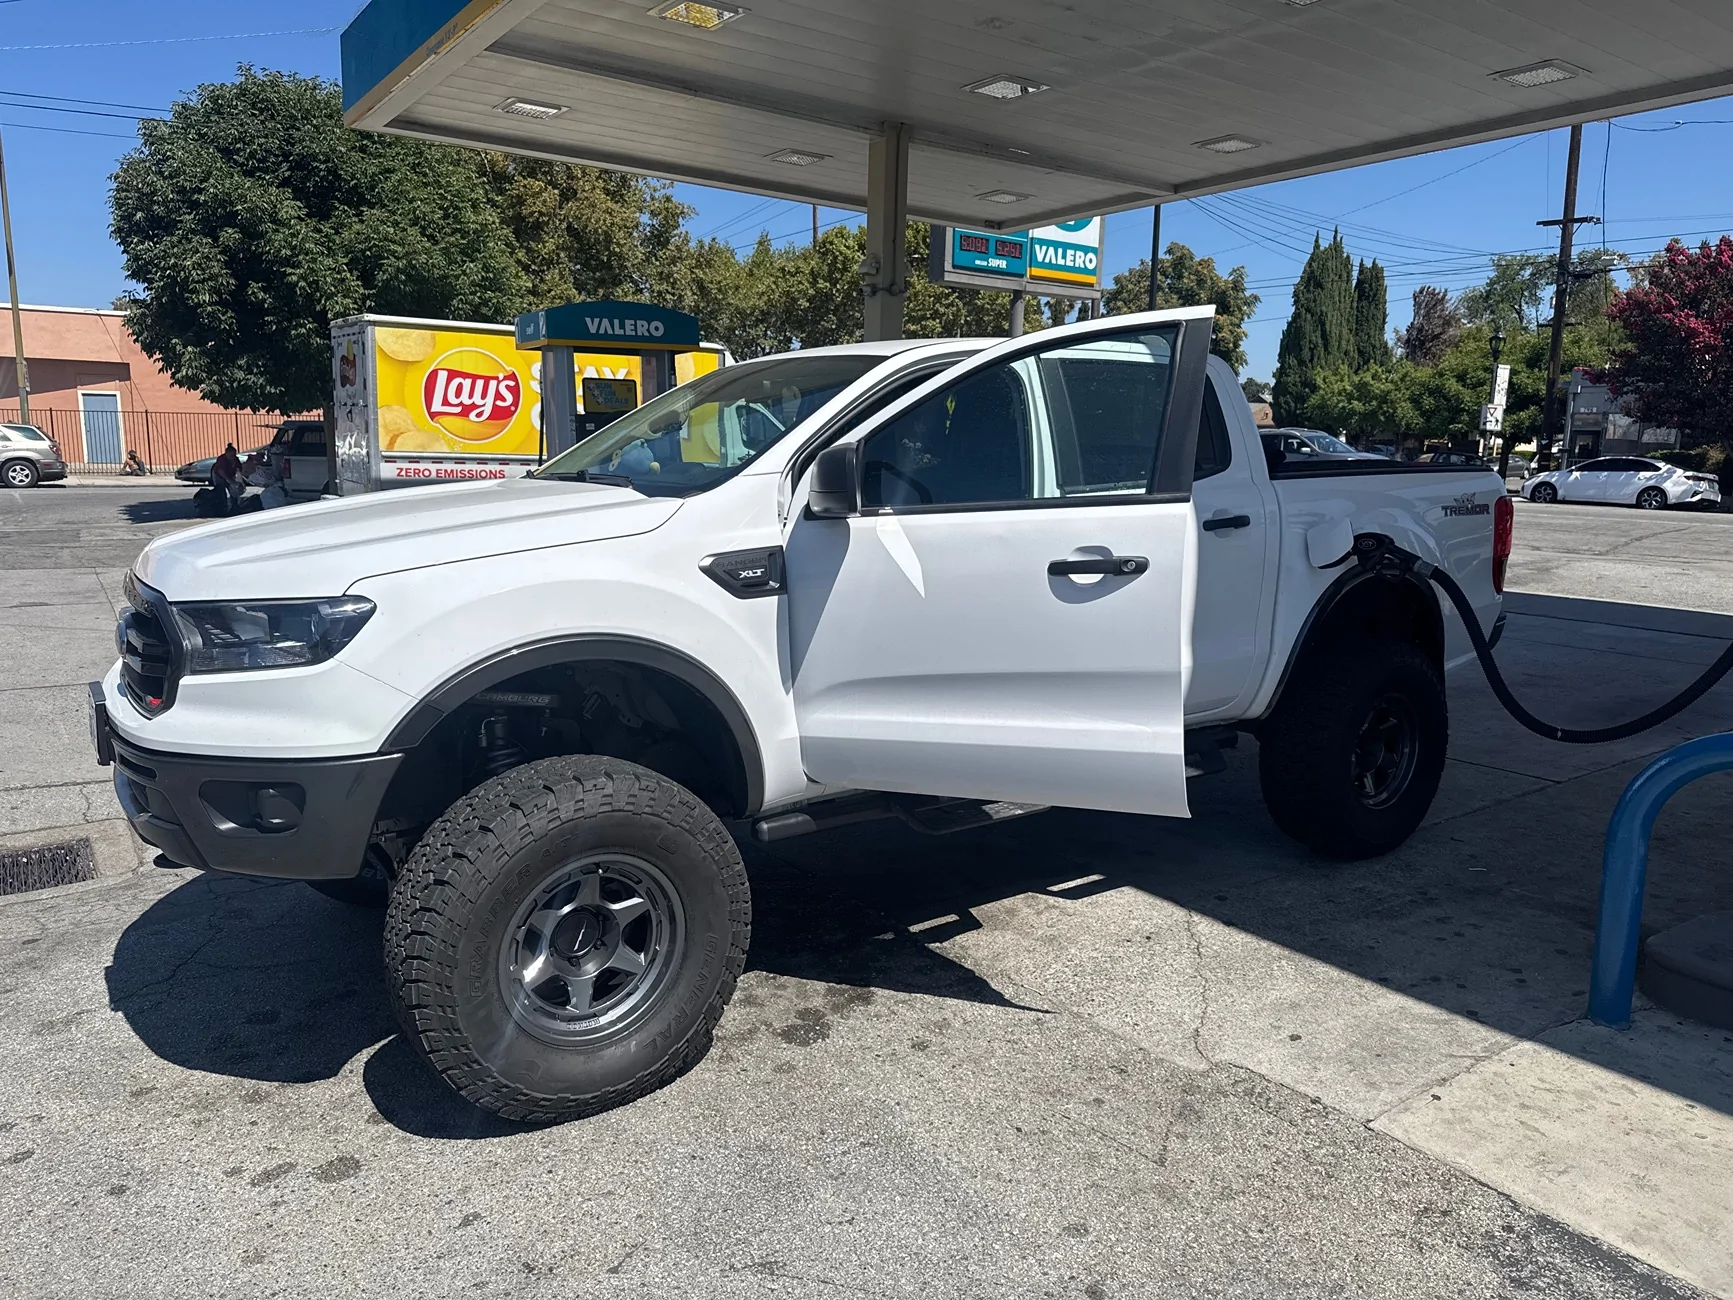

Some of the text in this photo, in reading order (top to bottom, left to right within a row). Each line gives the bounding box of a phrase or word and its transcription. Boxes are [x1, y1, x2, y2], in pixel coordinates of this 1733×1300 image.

[988, 258, 1007, 269] SUPER
[1035, 244, 1097, 270] VALERO
[585, 317, 665, 337] VALERO
[431, 370, 516, 422] Lay's
[396, 467, 506, 479] ZERO EMISSIONS
[1441, 504, 1490, 517] TREMOR
[738, 568, 765, 579] XLT
